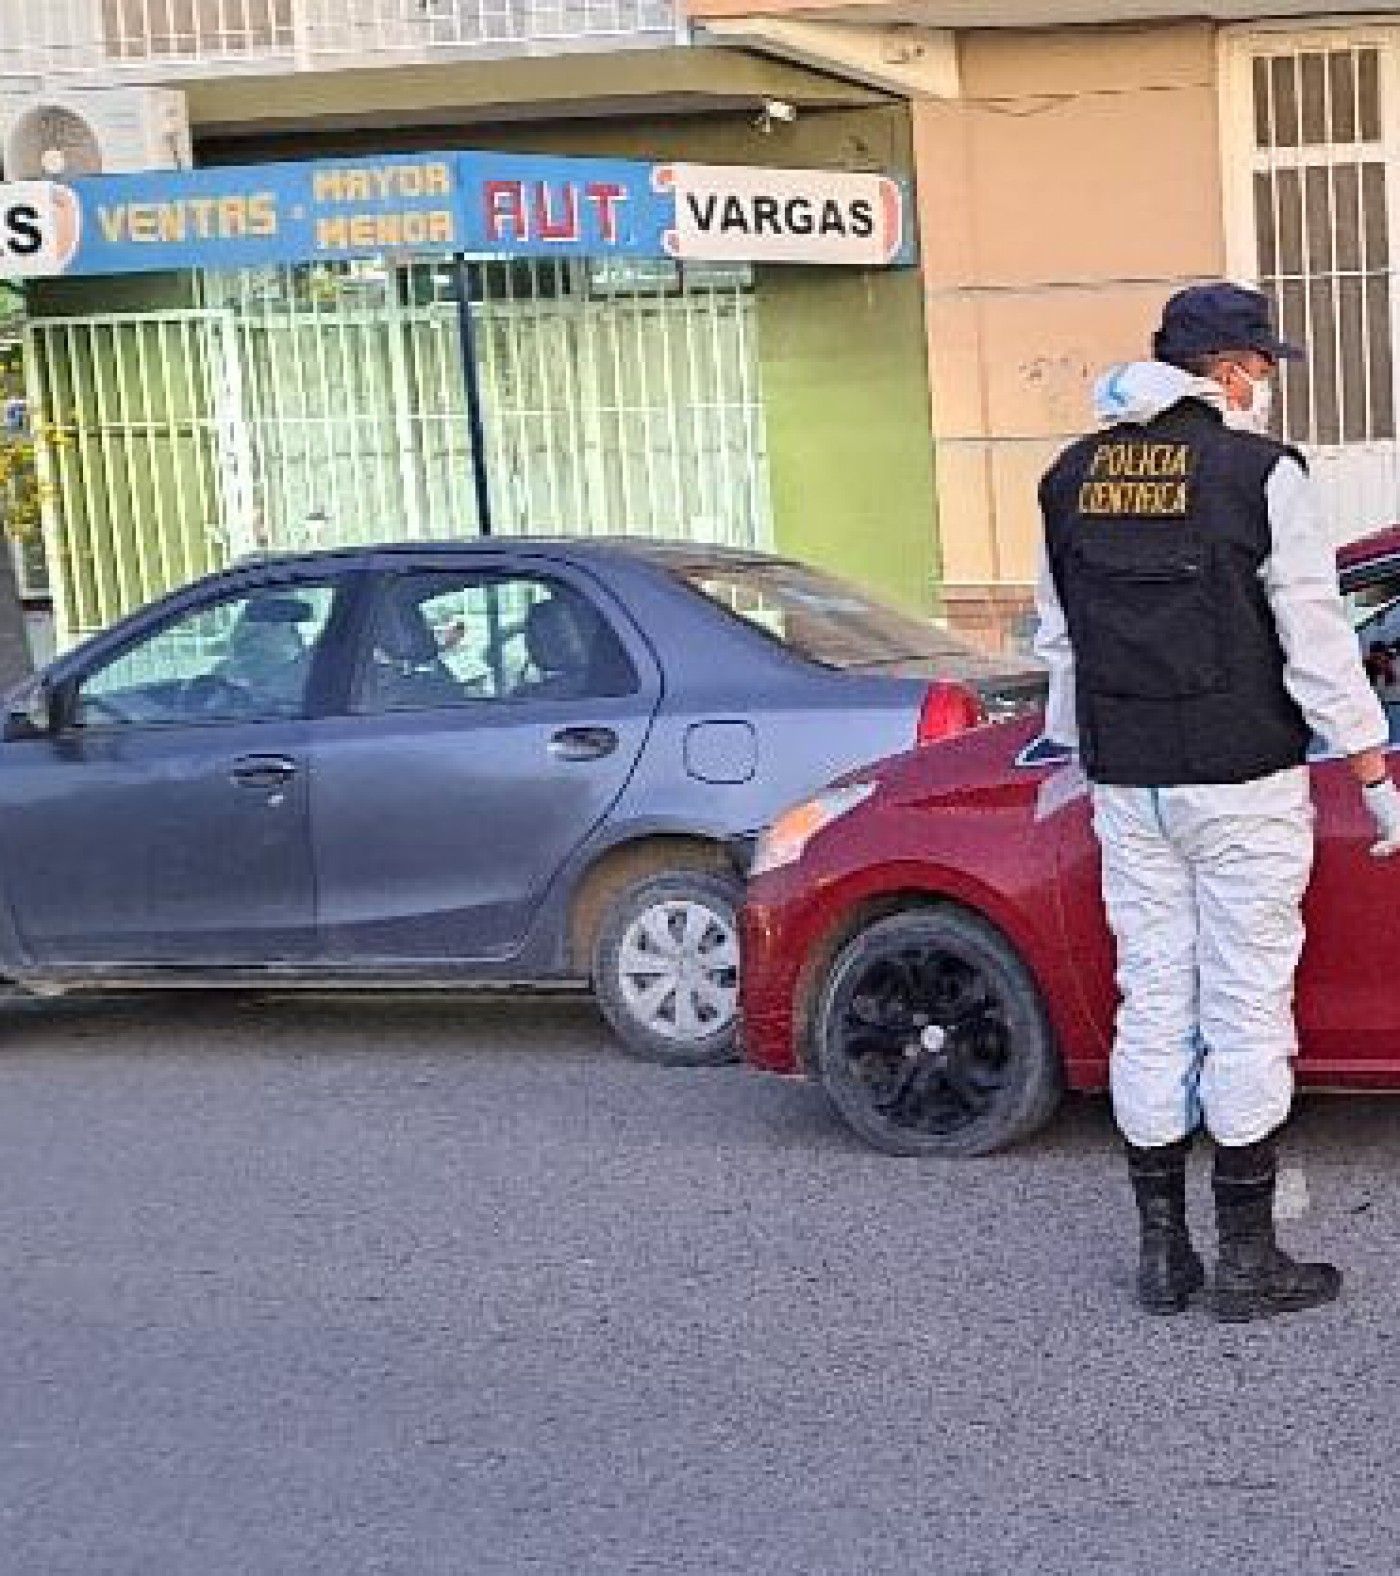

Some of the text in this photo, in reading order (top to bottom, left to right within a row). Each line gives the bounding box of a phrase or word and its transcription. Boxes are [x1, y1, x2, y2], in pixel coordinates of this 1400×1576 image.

[312, 163, 450, 201] MAYOR
[97, 192, 278, 243] VENTAS
[315, 210, 454, 250] MENOR
[686, 194, 874, 238] VARGAS
